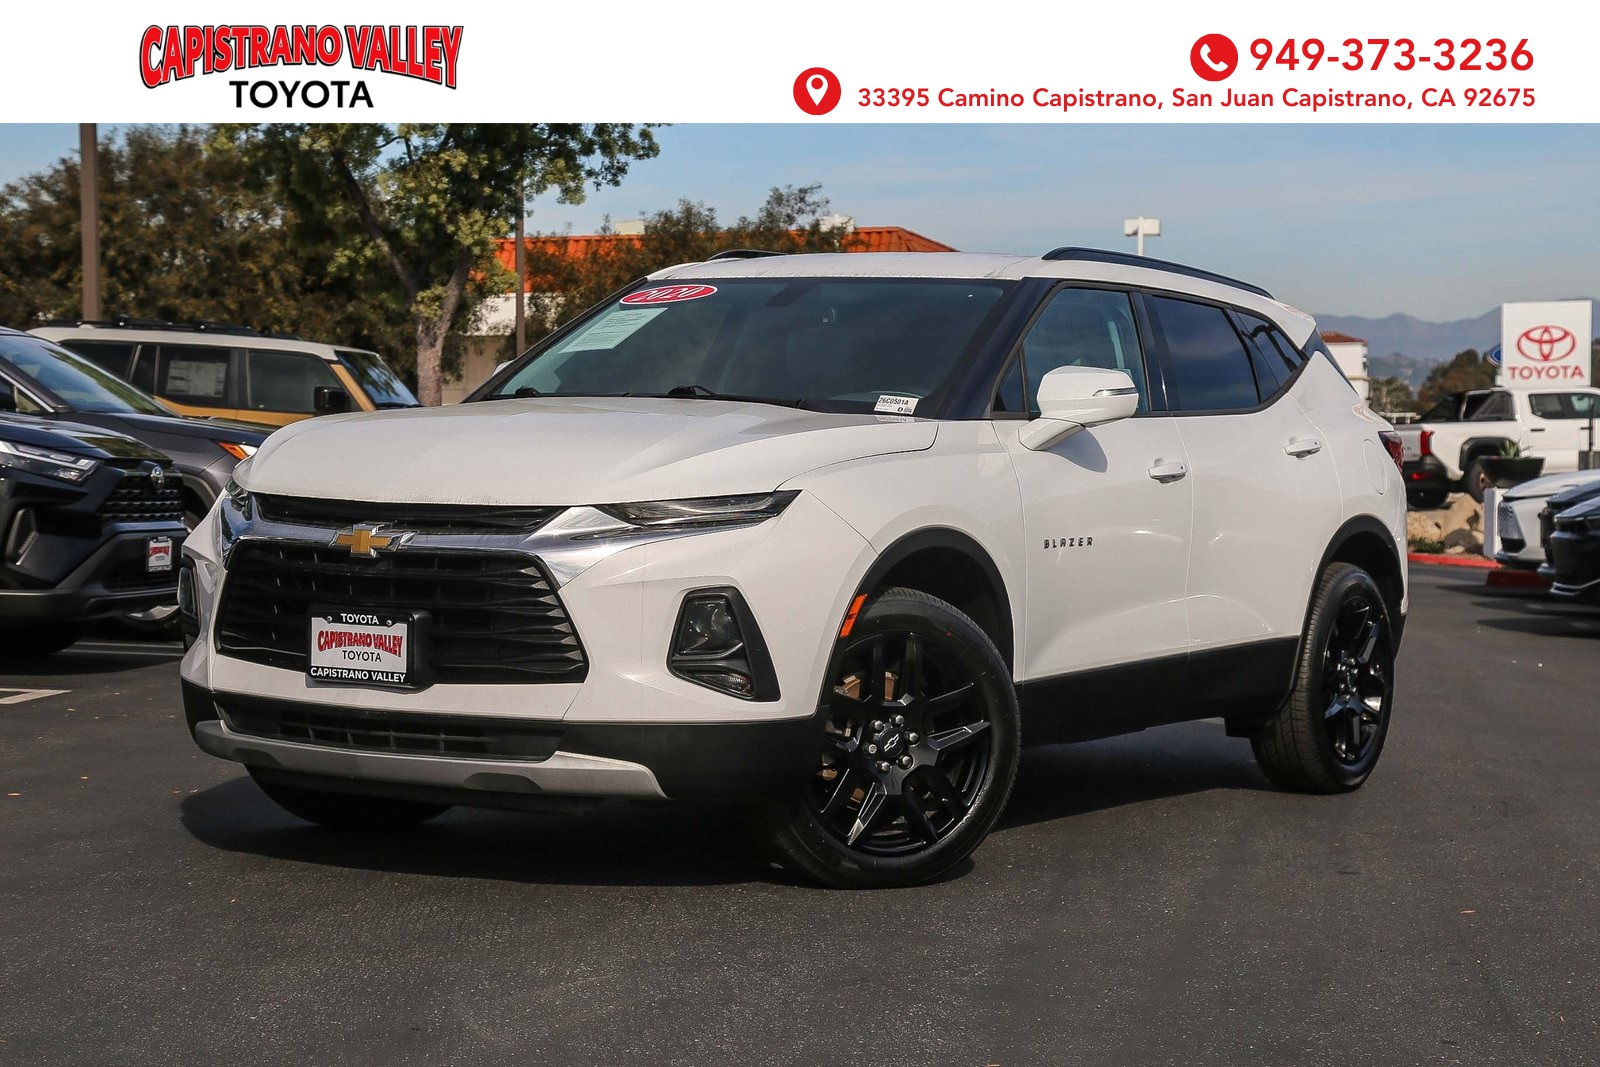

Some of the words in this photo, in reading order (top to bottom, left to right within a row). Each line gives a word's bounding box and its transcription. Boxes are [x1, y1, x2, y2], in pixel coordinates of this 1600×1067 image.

[1508, 365, 1584, 380] TOYOTA
[1043, 536, 1093, 549] BLAZER
[340, 613, 380, 625] TOYOTA
[317, 630, 373, 652] CAPISTRANO
[372, 633, 403, 658] VALLEY
[342, 649, 382, 663] TOYOTA
[310, 667, 369, 680] CAPISTRANO
[371, 671, 406, 683] VALLEY
